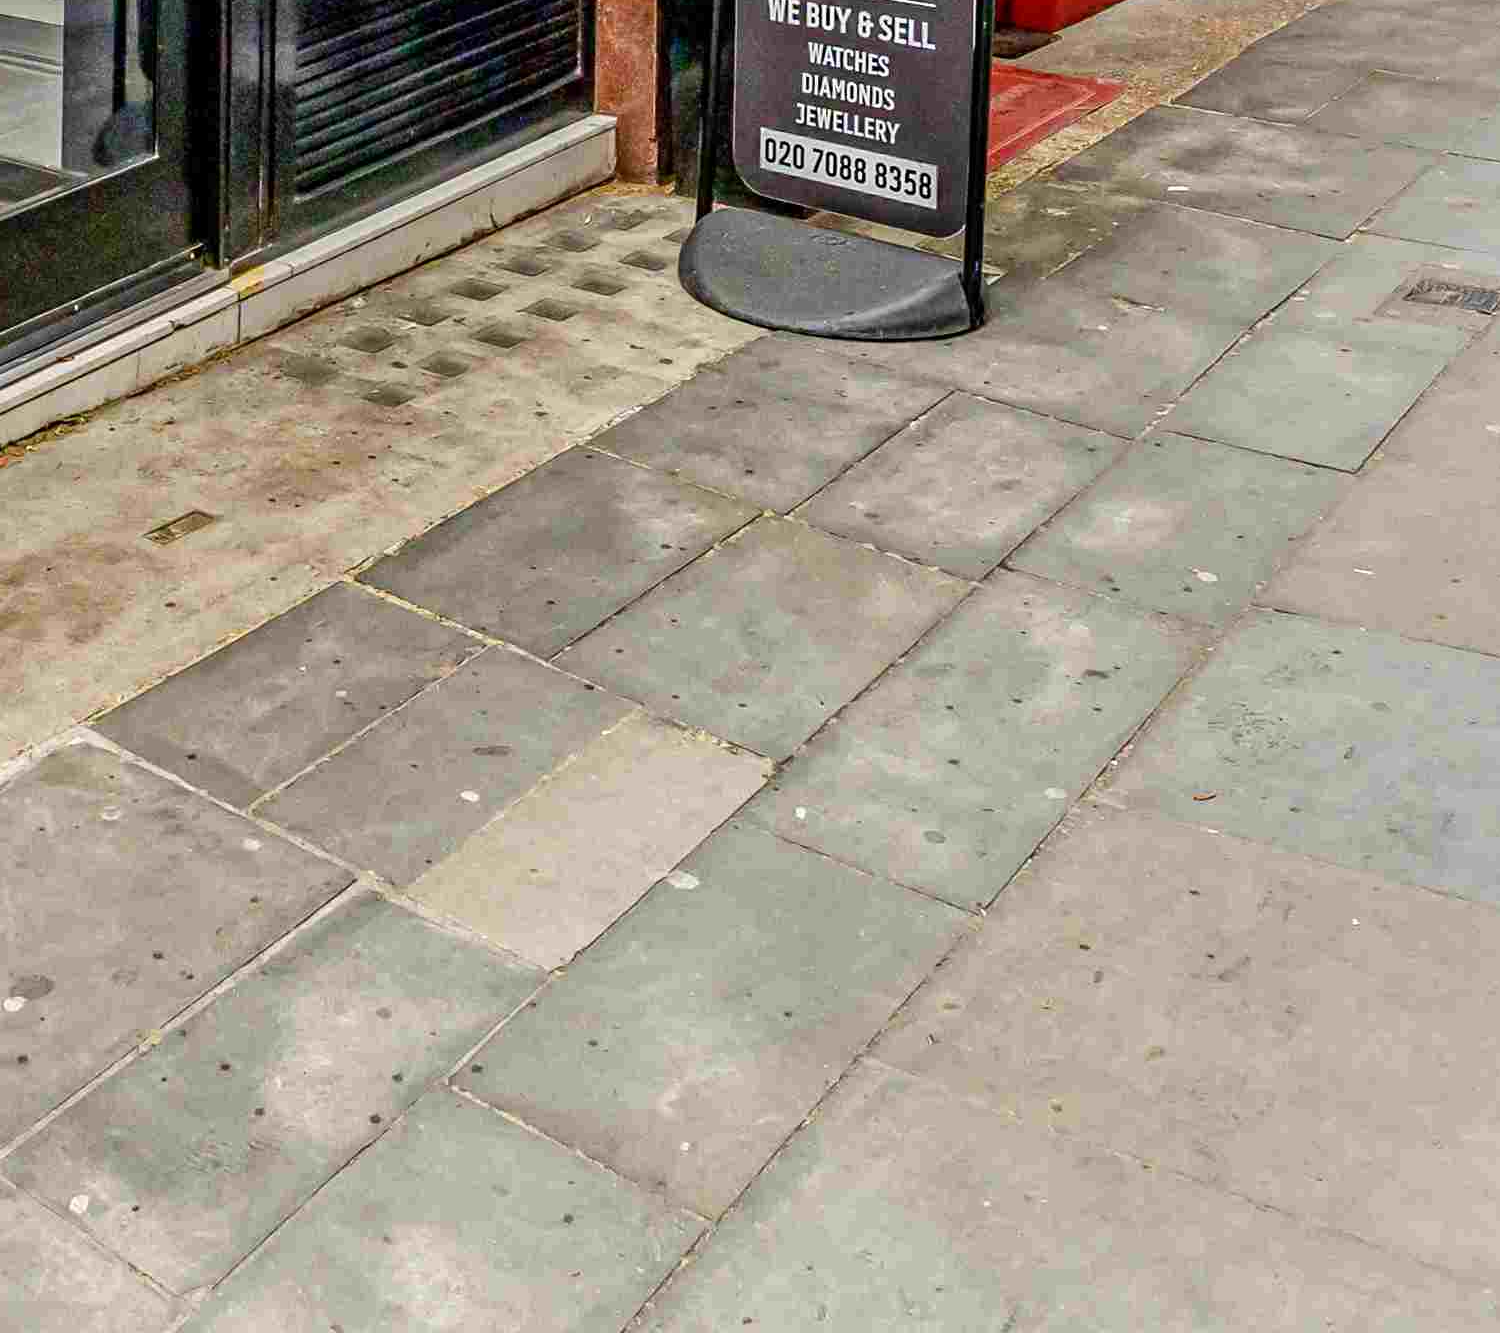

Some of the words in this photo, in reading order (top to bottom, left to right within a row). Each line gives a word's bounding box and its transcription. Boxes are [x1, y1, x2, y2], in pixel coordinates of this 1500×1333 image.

[806, 2, 851, 35] BUY
[857, 11, 875, 39] &
[879, 15, 937, 51] SELL
[808, 42, 890, 78] WATCHES
[801, 72, 896, 111] DIAMONDS
[795, 103, 902, 145] JEWELLERY
[765, 137, 805, 170] 020
[811, 146, 868, 185] 7088
[874, 159, 933, 200] 8358
